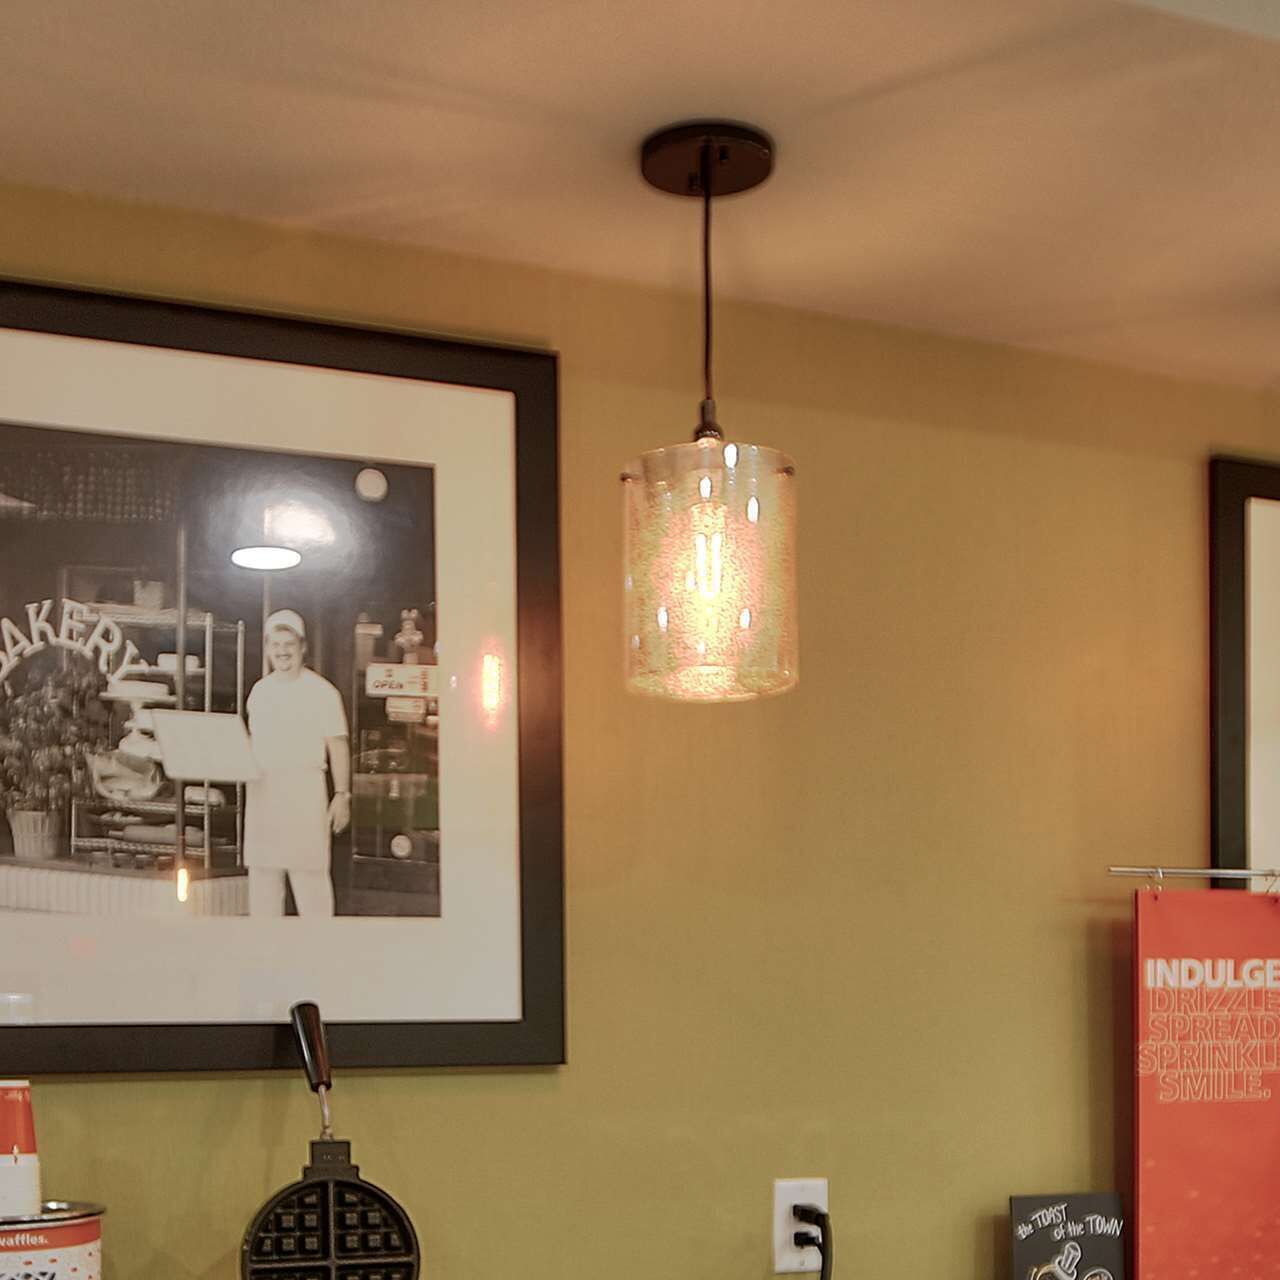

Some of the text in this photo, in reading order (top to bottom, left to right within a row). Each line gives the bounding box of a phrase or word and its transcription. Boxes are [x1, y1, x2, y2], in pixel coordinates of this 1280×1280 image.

[1149, 986, 1280, 1015] DRIZZLE
[1159, 1069, 1272, 1101] SMILE.
[1017, 1203, 1067, 1239] the TOAST
[1054, 1214, 1124, 1240] of the TOWN
